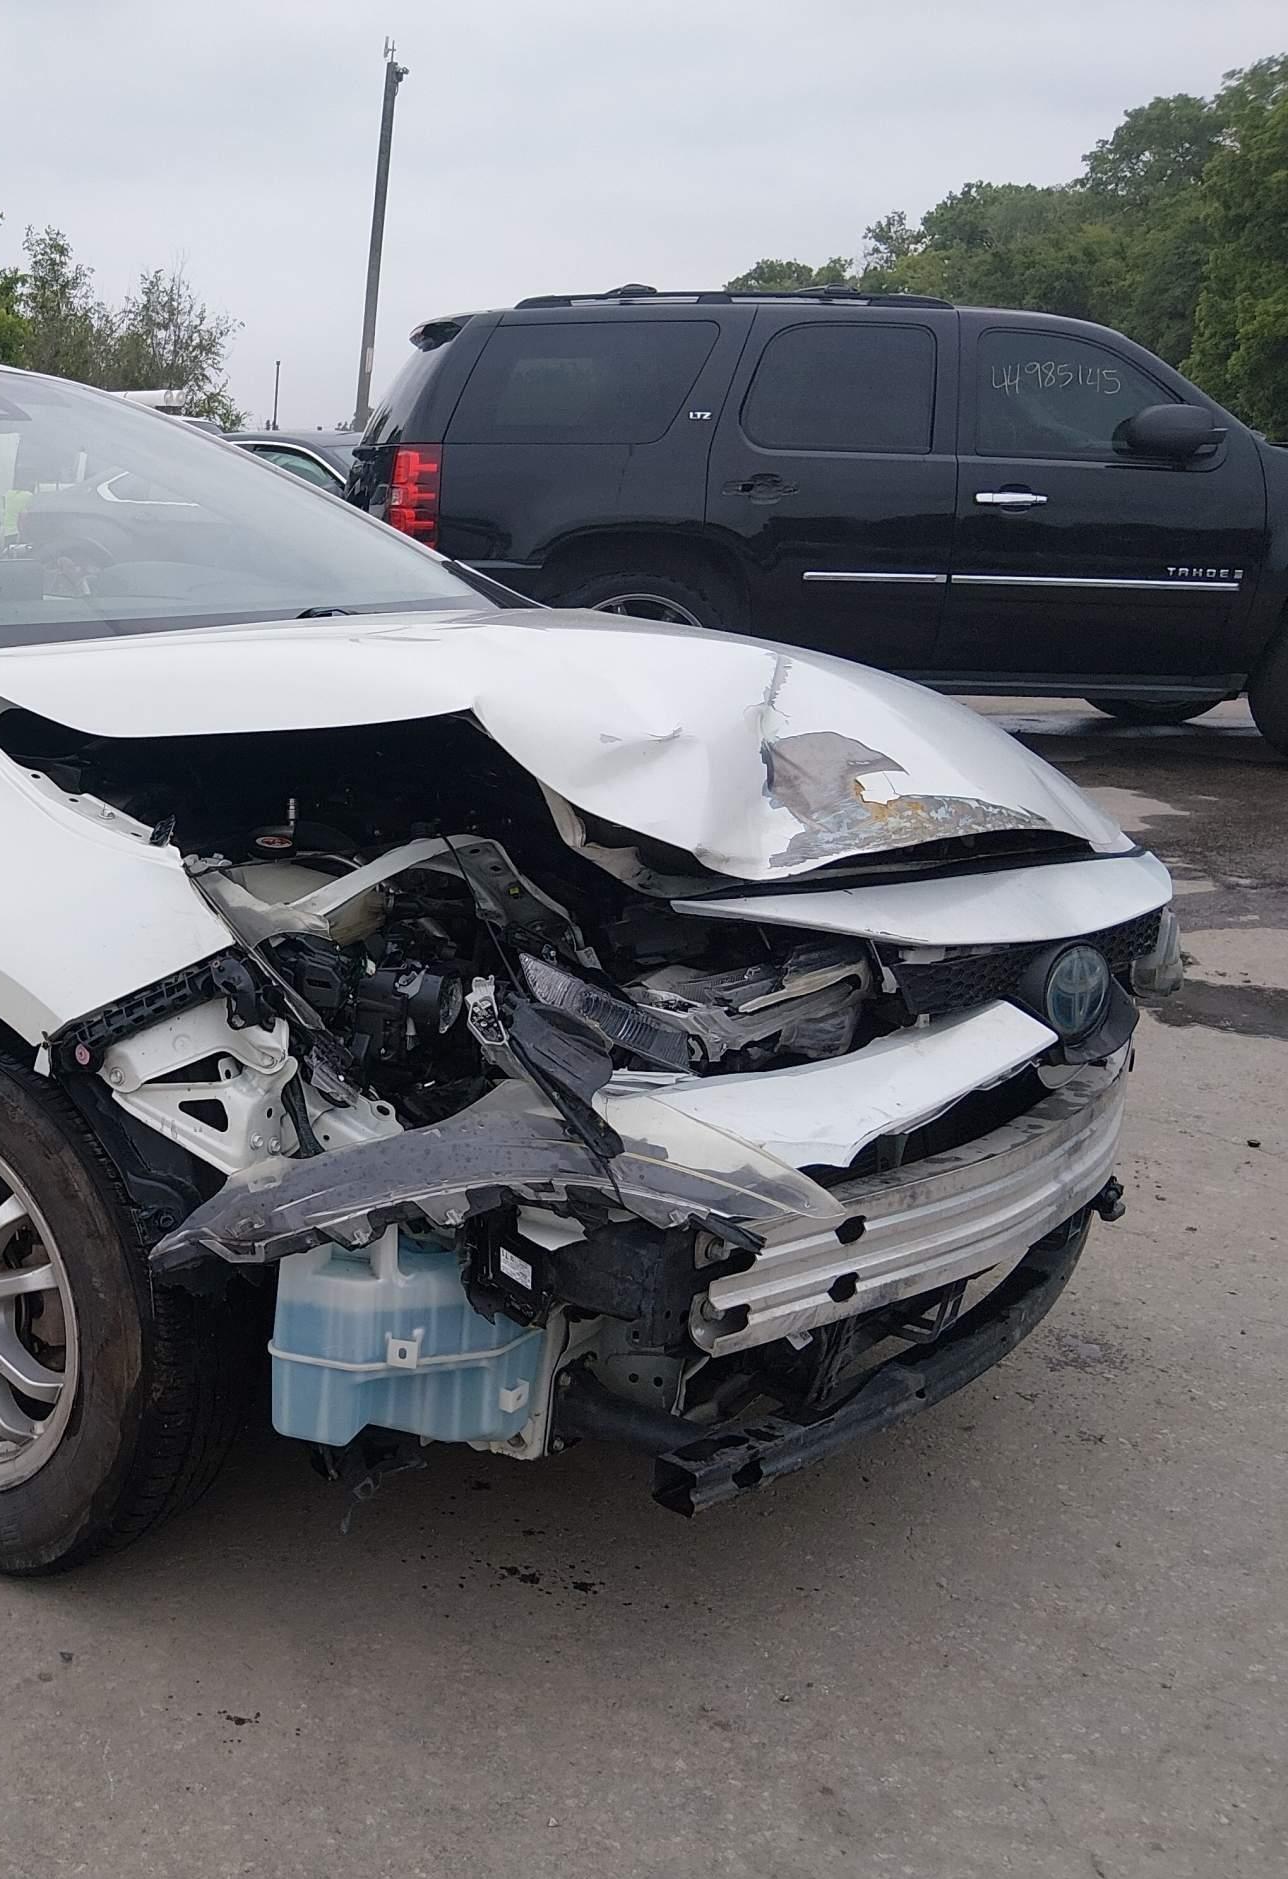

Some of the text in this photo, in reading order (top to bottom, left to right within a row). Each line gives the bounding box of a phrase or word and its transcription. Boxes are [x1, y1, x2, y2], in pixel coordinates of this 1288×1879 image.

[991, 361, 1121, 396] 44985145
[689, 411, 712, 420] LTZ
[1167, 567, 1230, 578] TAHOE
